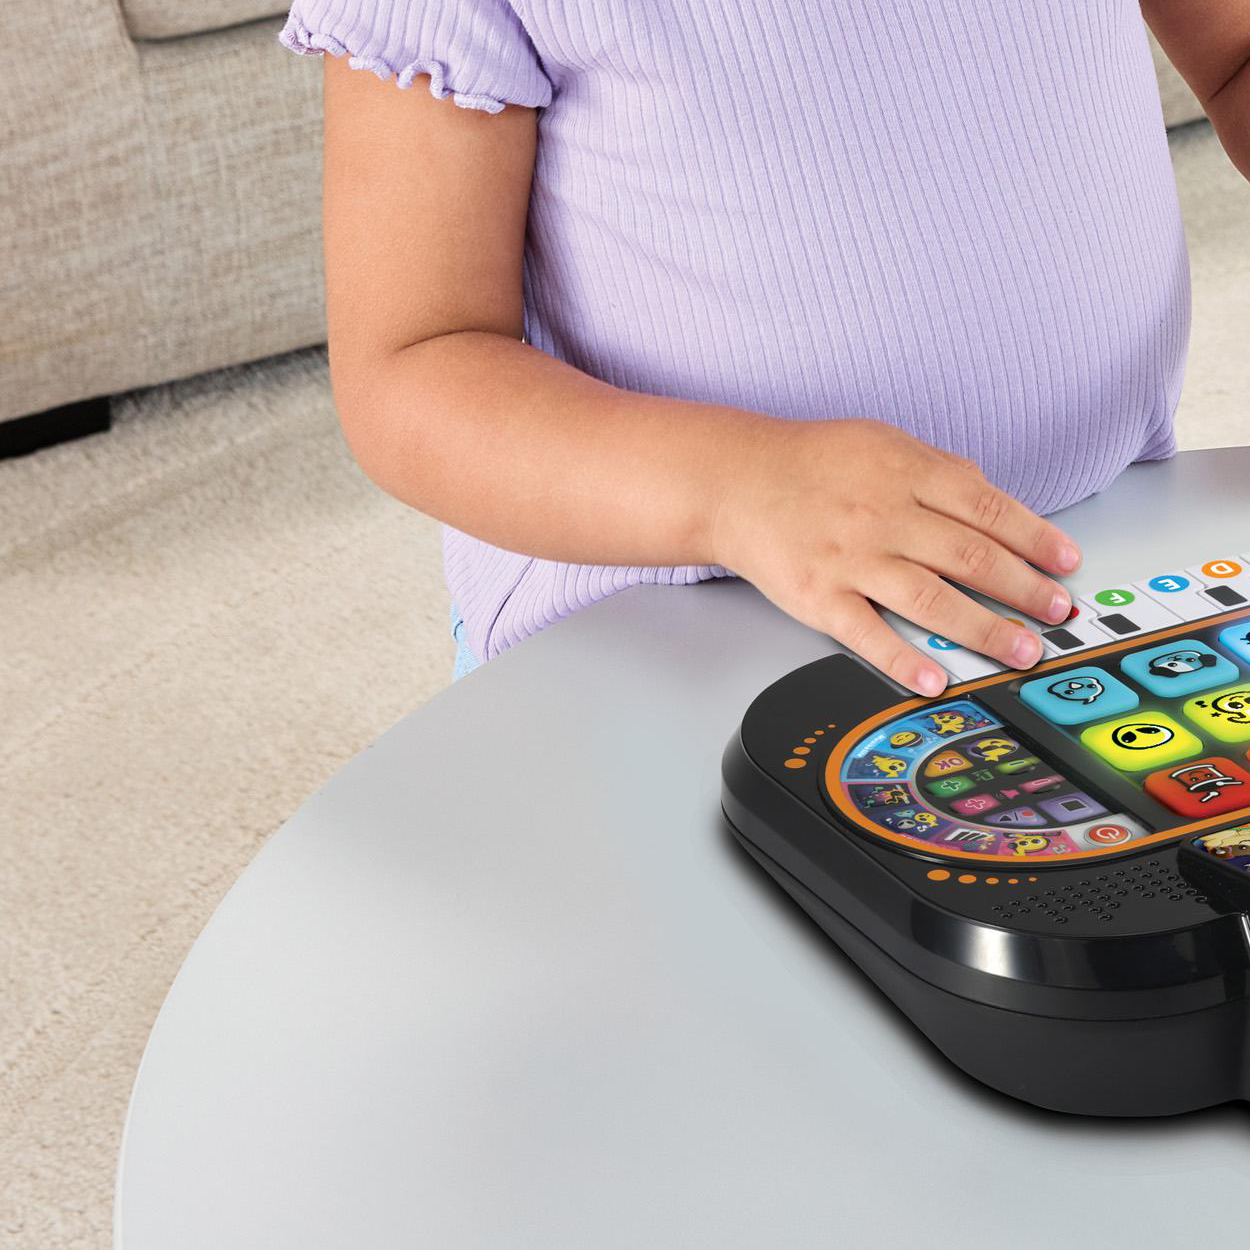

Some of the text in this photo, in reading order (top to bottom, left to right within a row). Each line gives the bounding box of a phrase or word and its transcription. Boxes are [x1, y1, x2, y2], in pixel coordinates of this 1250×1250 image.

[1209, 562, 1235, 575] D
[1157, 578, 1182, 590] E
[1107, 592, 1127, 604] F
[934, 757, 964, 772] OK
